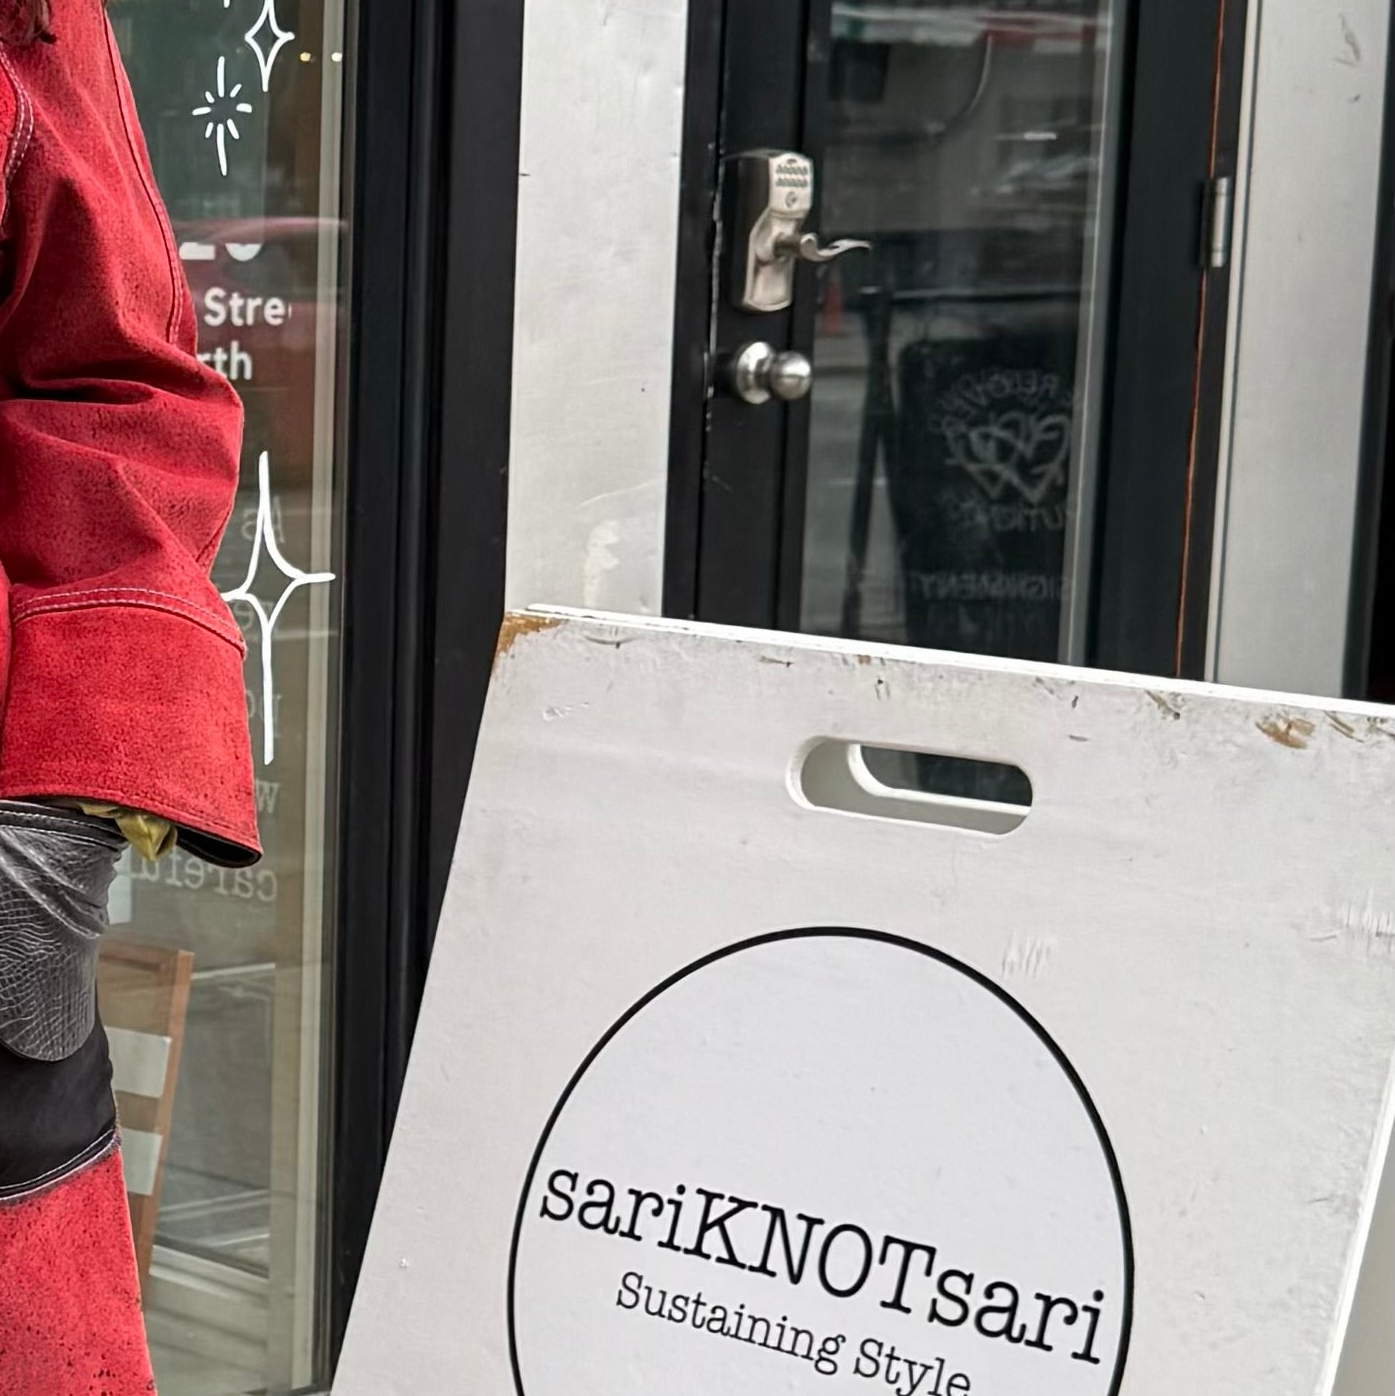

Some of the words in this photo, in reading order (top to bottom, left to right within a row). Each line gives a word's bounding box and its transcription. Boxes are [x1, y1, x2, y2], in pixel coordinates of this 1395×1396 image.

[203, 285, 292, 327] Stre
[540, 1168, 1105, 1365] sariKNOTsari
[615, 1271, 846, 1376] Sustaining
